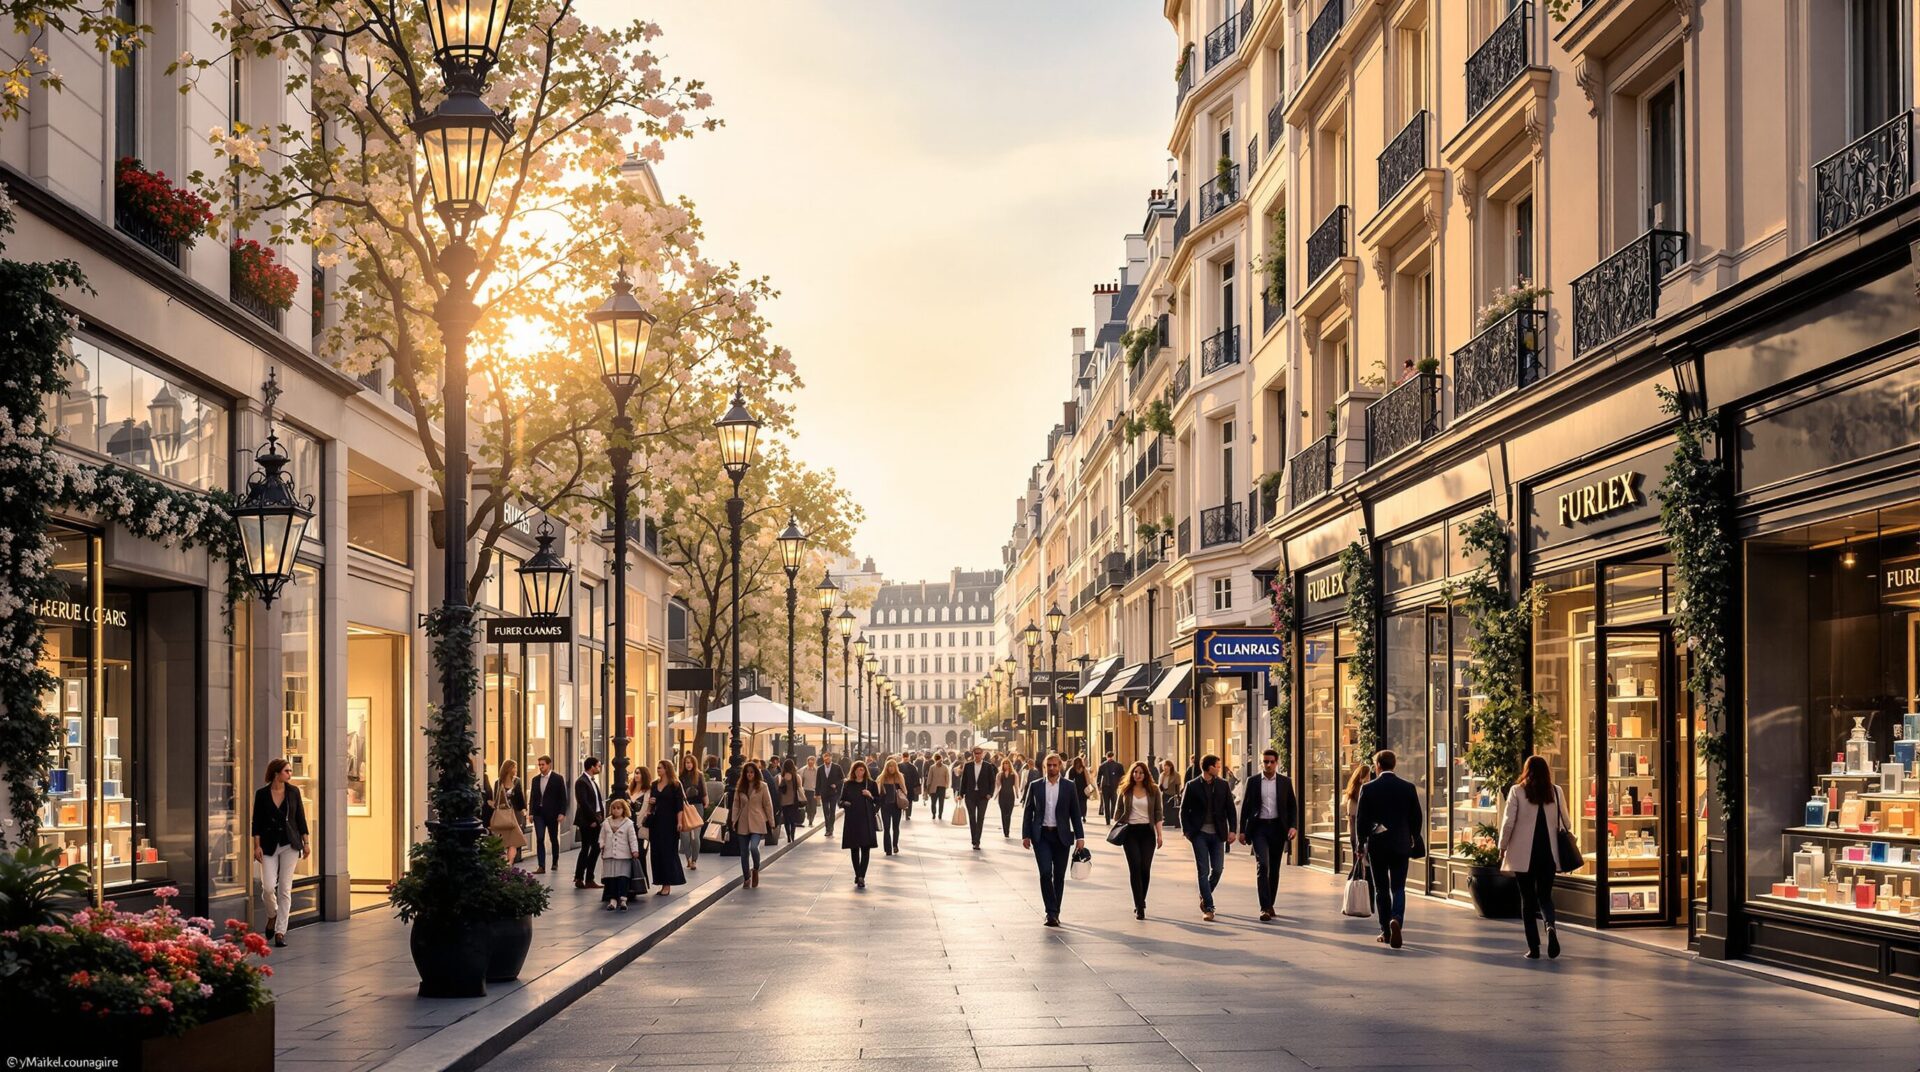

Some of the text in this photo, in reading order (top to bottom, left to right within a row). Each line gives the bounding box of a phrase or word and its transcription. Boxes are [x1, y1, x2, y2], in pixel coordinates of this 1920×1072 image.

[1558, 470, 1637, 526] FURLEX
[1307, 571, 1345, 603] FURLEX
[1213, 643, 1280, 656] CILANRALS
